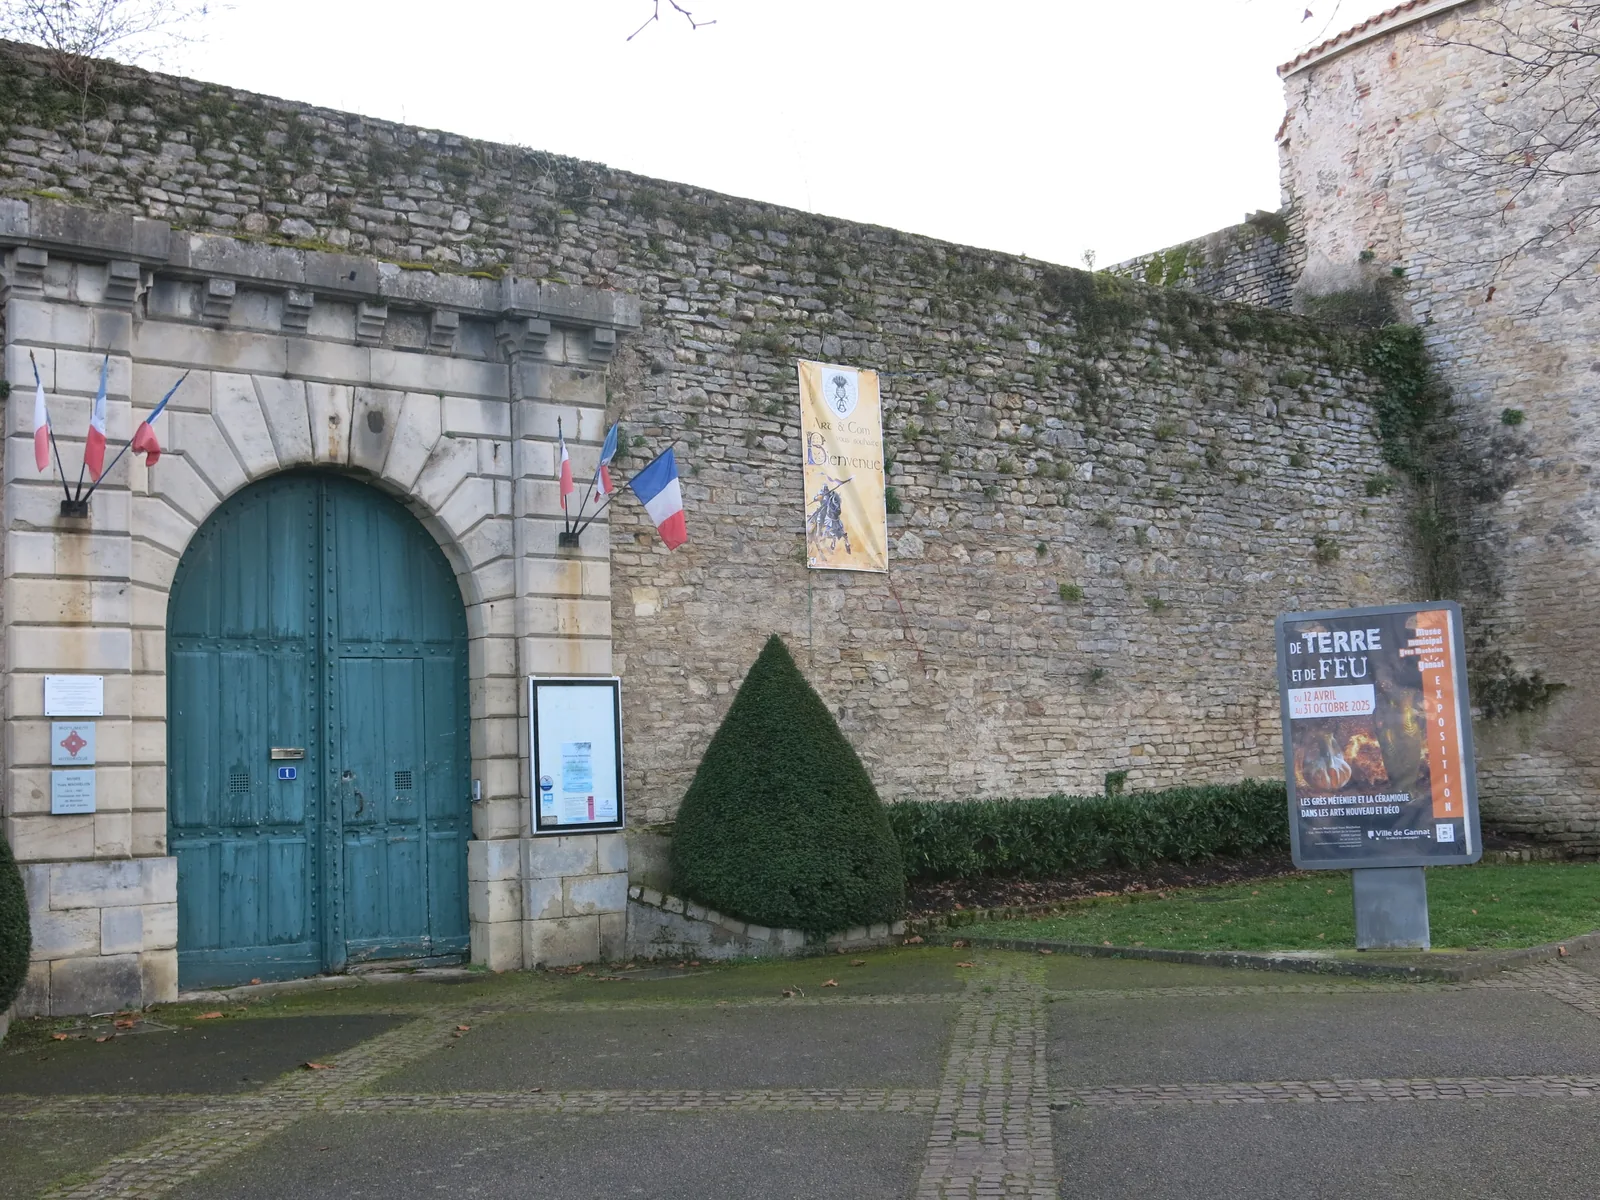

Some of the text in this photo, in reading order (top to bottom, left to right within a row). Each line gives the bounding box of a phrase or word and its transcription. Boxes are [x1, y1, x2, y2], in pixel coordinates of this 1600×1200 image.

[837, 422, 845, 432] &
[848, 421, 871, 435] Com
[806, 431, 881, 471] Bienvenue
[1290, 628, 1382, 654] DE TERRE
[1291, 655, 1368, 682] ET DE FEU
[1304, 691, 1312, 702] 12
[1313, 690, 1337, 701] AVRIL
[1303, 703, 1312, 714] 31
[1313, 701, 1349, 713] OCTOBRE
[1351, 700, 1371, 712] 2025
[1435, 675, 1452, 812] EXPOSITION
[1300, 797, 1311, 806] LES
[1311, 795, 1327, 806] GRÈS
[1357, 795, 1366, 804] ET
[1366, 794, 1375, 804] LA
[1374, 793, 1410, 803] CÉRAMIQUE
[1301, 804, 1400, 818] DANS LES ARTS NOUVEAU ET DÉCO
